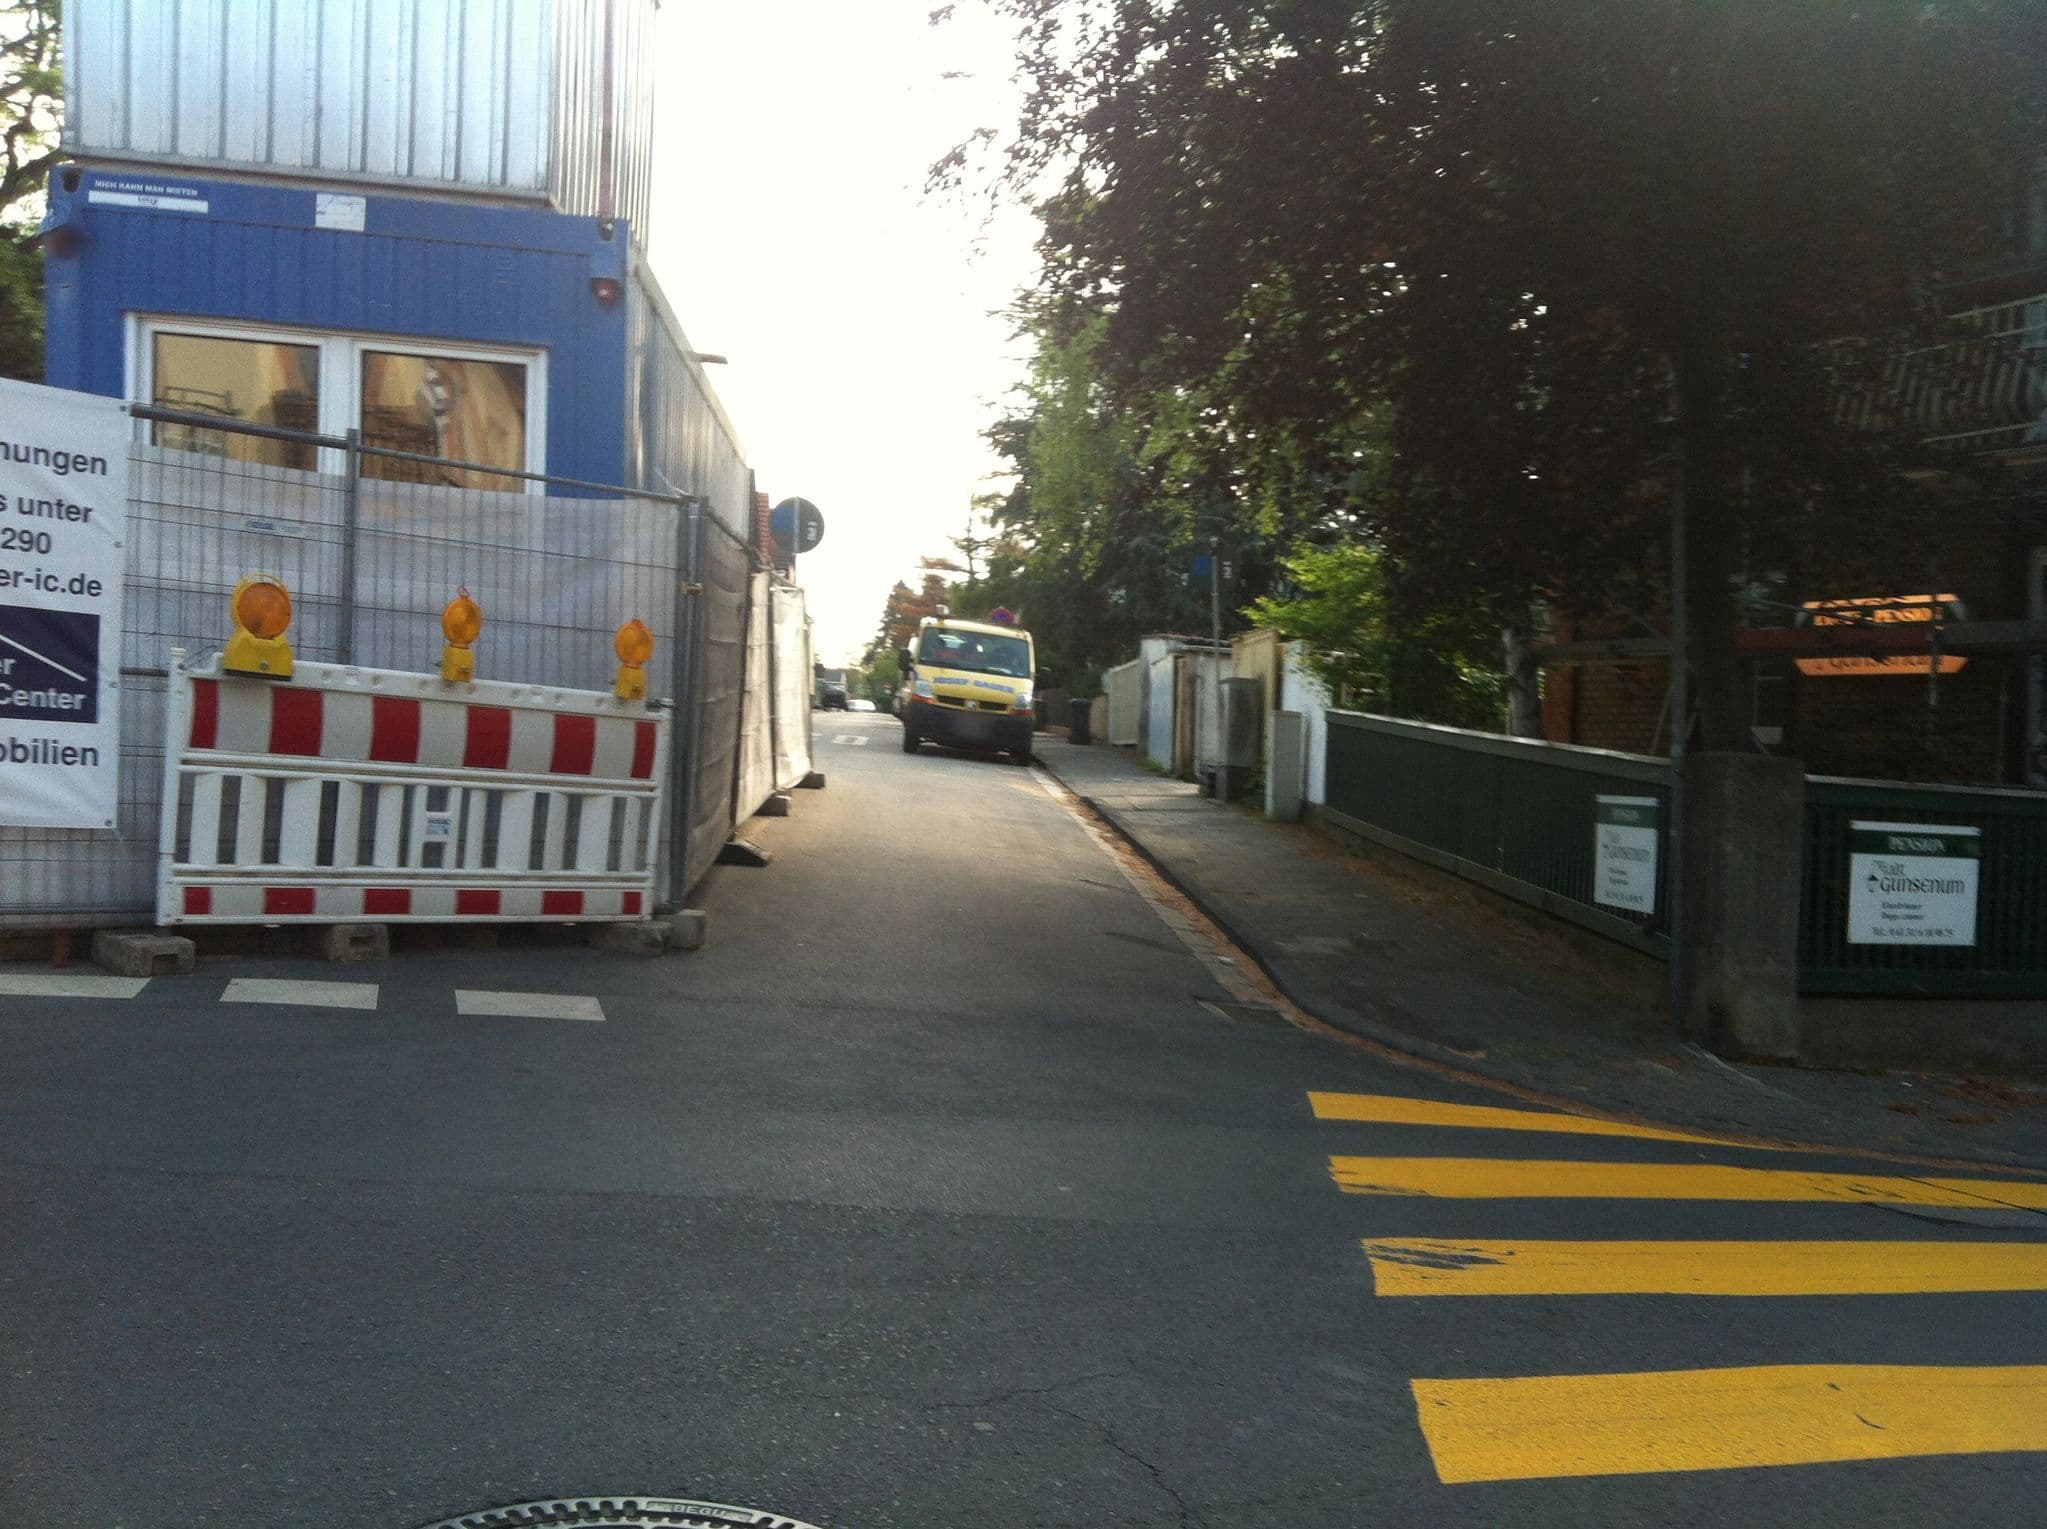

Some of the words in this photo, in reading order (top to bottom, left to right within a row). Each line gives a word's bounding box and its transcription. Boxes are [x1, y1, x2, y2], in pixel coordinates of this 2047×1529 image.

[17, 496, 94, 523] unter
[0, 527, 52, 555] 290
[0, 567, 102, 597] er-ic.de
[0, 682, 87, 710] Center
